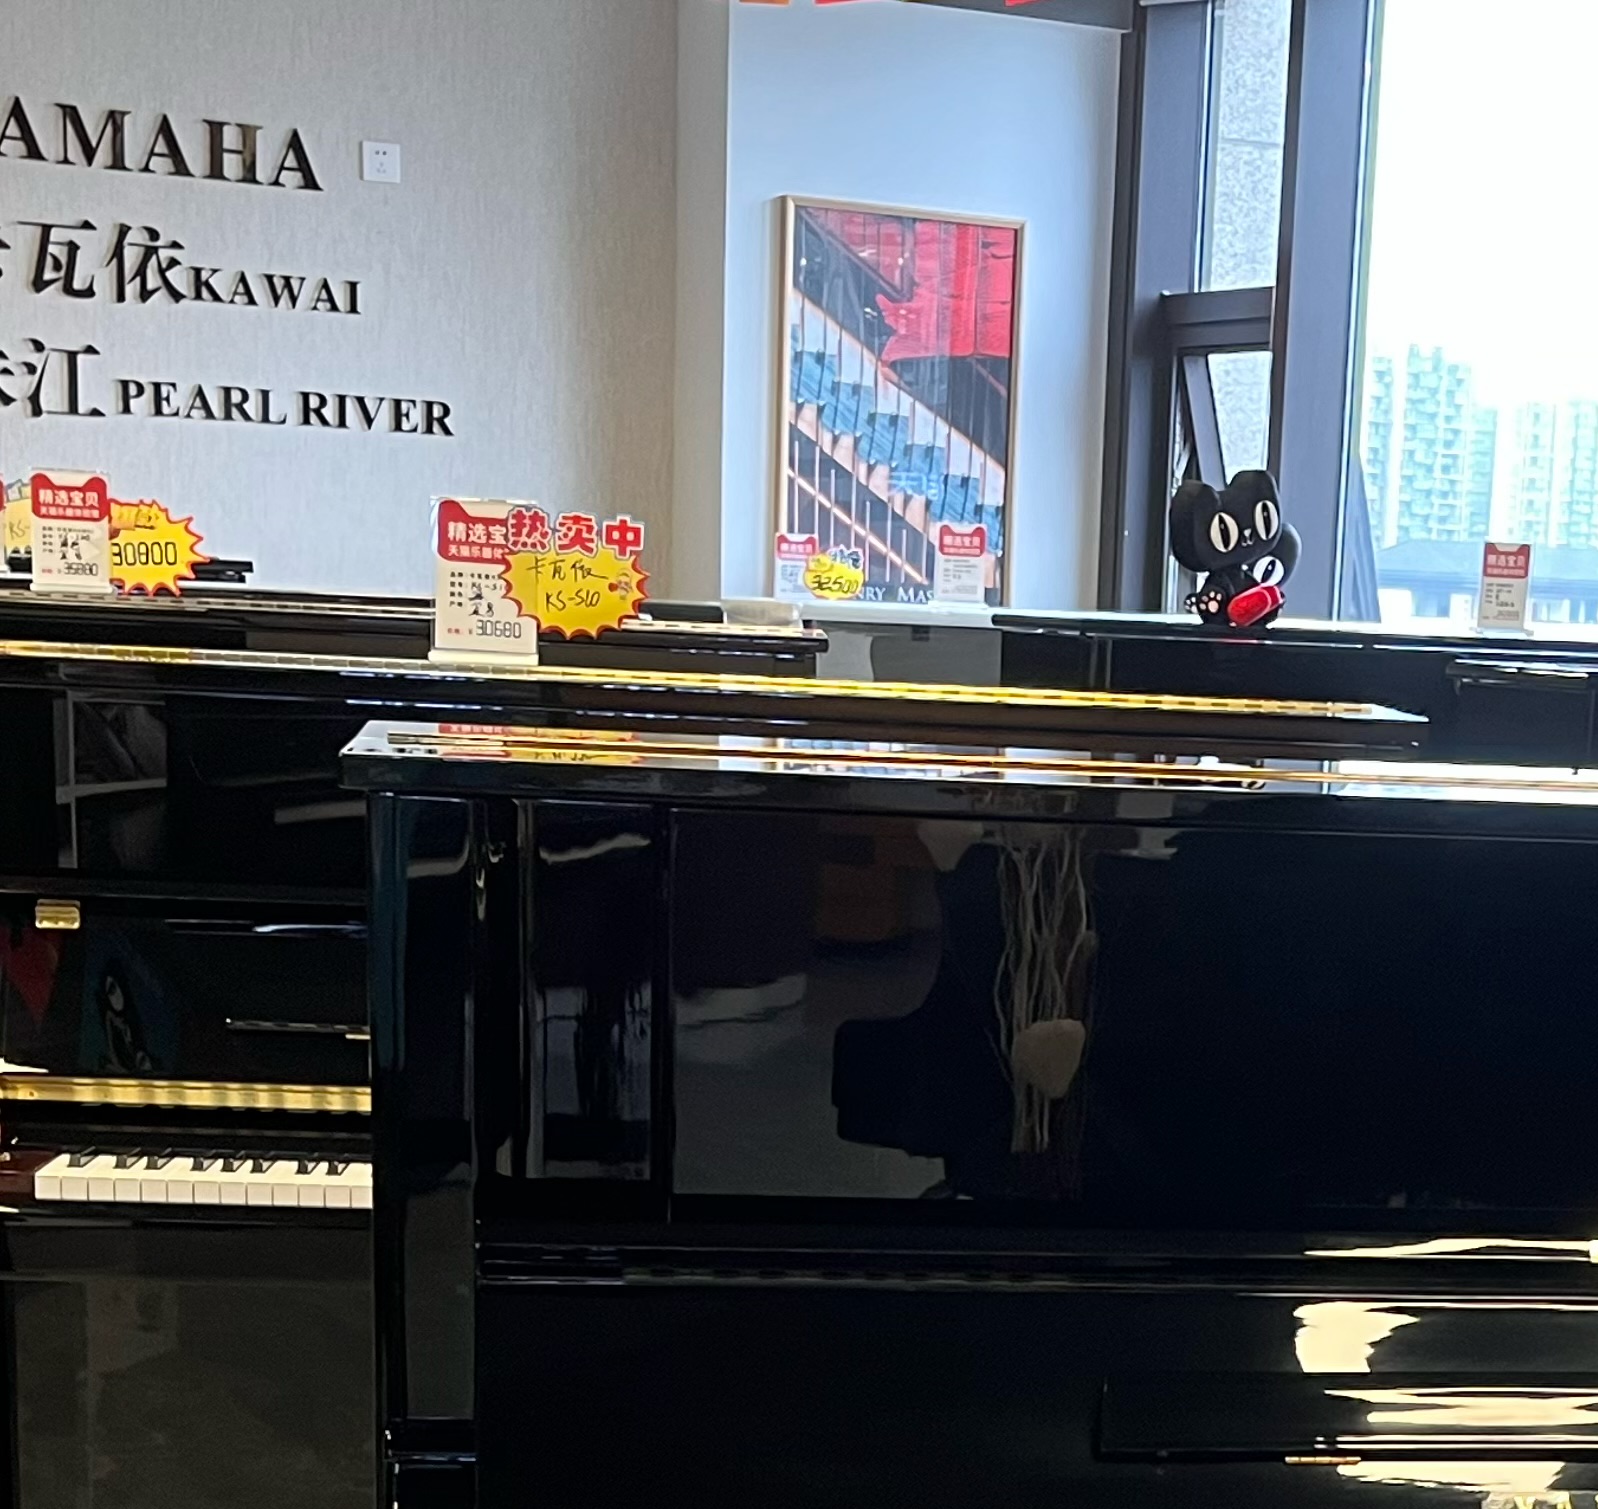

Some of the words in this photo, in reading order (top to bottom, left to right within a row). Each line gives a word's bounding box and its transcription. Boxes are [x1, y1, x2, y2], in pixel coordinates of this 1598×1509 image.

[0, 219, 187, 304] 瓦依
[187, 266, 362, 314] KAWAI
[117, 378, 287, 425] PEARL
[297, 390, 455, 437] RIVER
[509, 509, 643, 559] 热卖中
[475, 619, 522, 639] 30680
